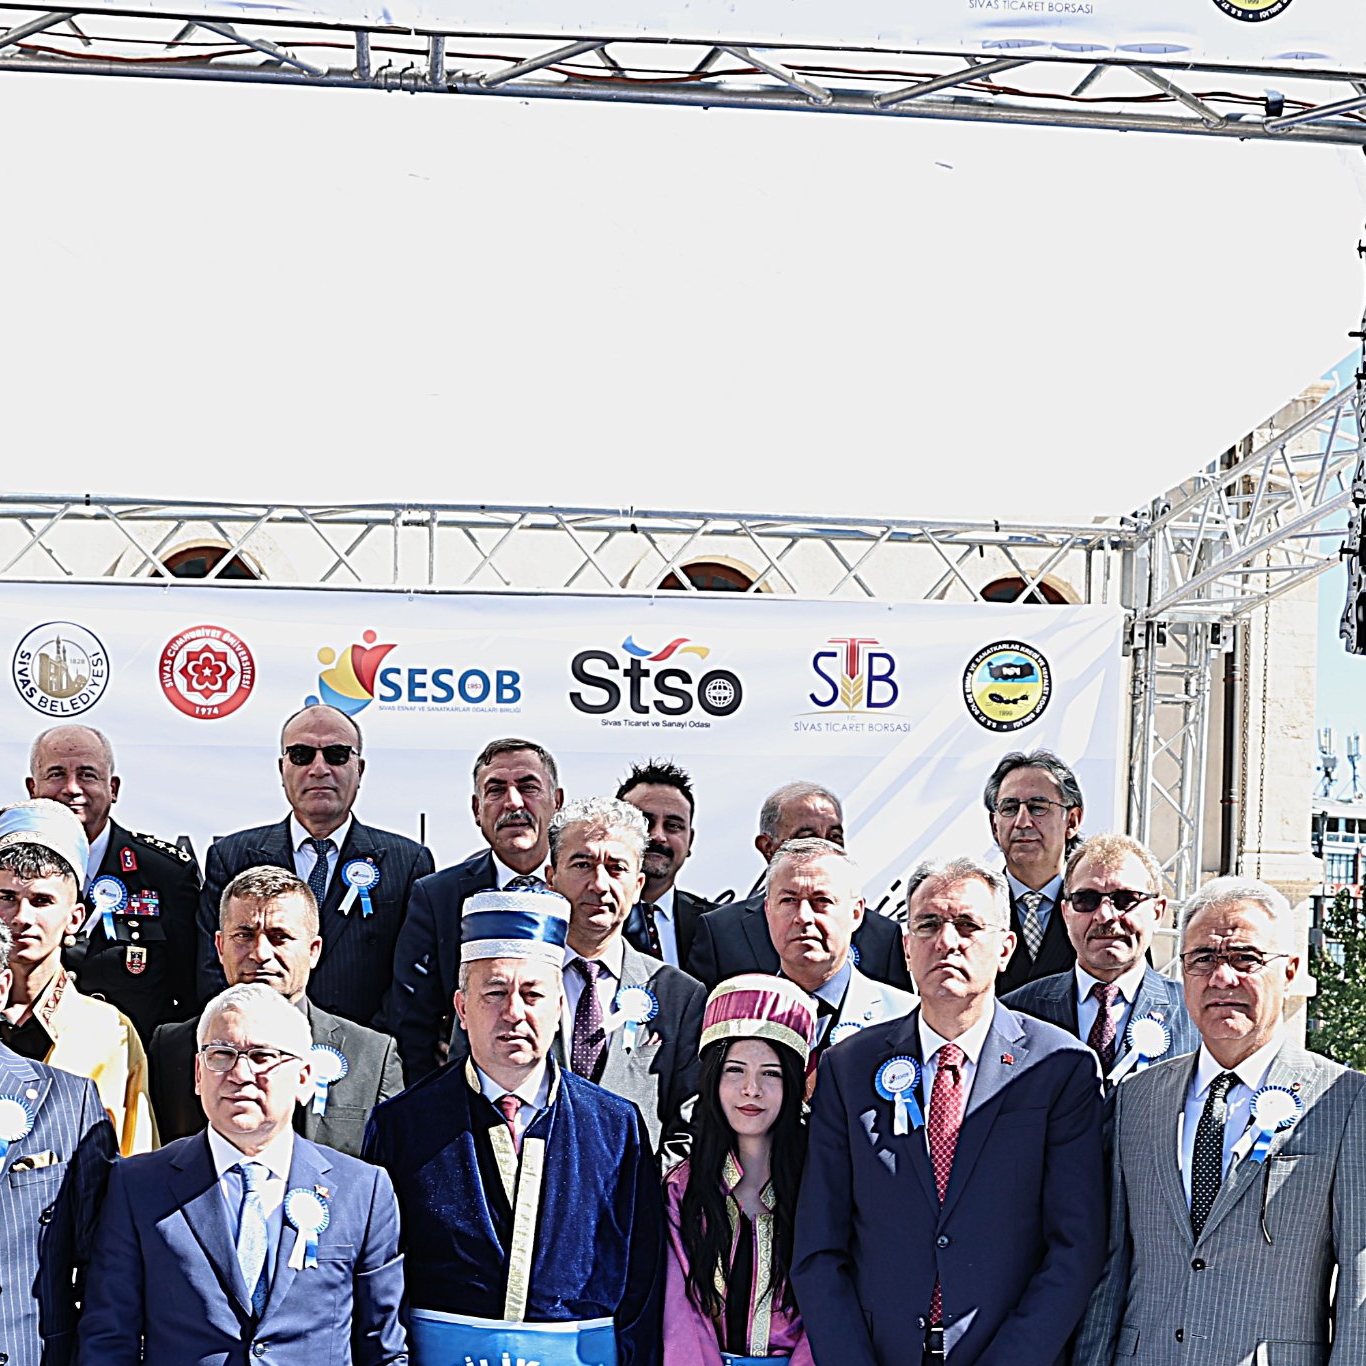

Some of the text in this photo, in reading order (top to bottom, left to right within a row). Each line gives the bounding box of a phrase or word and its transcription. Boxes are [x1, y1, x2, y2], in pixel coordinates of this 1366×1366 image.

[1048, 2, 1093, 14] BORSASI
[17, 650, 104, 712] SİVAS BELEDİYESİ
[379, 667, 521, 704] SESOB
[569, 649, 743, 716] Stso
[195, 706, 219, 715] 1974
[601, 718, 622, 727] Sivas
[623, 719, 650, 727] Ticaret
[661, 720, 688, 729] Sanayi
[688, 720, 711, 728] Odası
[793, 720, 911, 733] SİVAS TİCARET BORSASI
